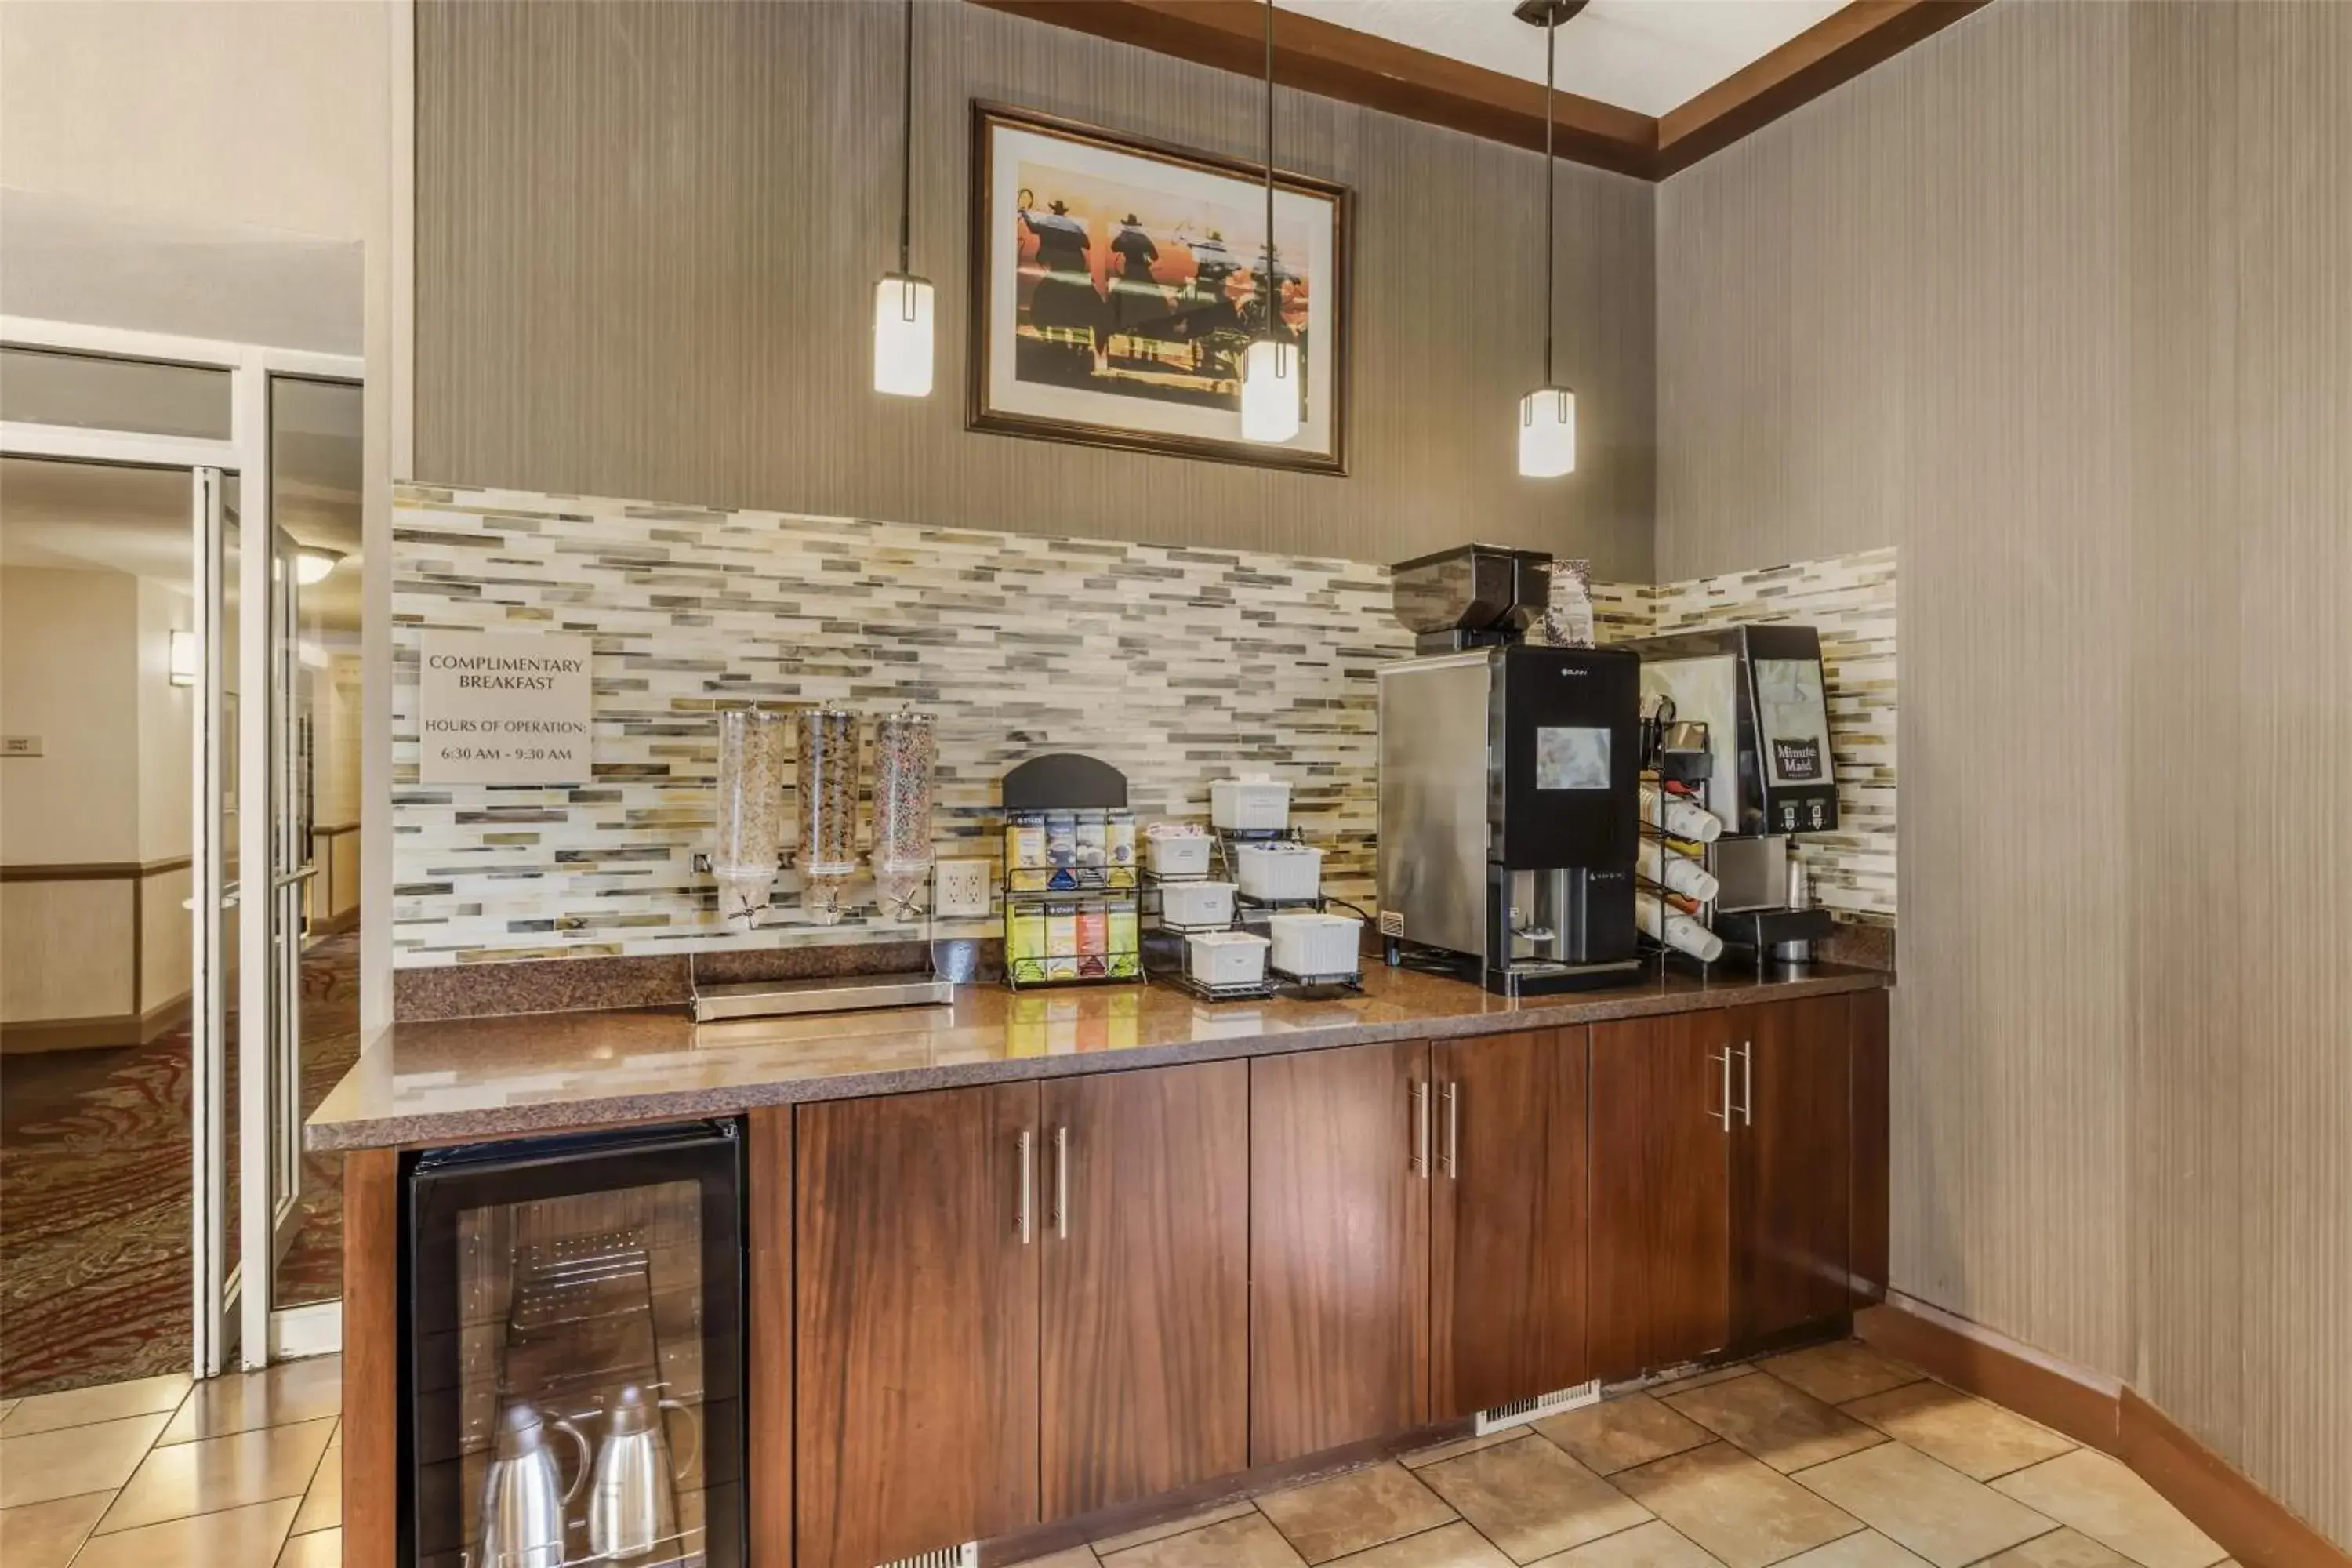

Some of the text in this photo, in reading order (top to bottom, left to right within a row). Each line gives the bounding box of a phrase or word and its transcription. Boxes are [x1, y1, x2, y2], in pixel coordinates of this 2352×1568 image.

[429, 655, 583, 673] COMPLIMENTARY
[459, 675, 554, 690] BREAKFAST
[426, 720, 587, 734] HOURS OF OPERATION:
[441, 748, 471, 760] 6:30
[475, 748, 500, 760] AM
[515, 749, 544, 760] 9:30
[549, 749, 572, 760] AM
[1777, 744, 1817, 758] Minute
[1784, 758, 1813, 772] Maid
